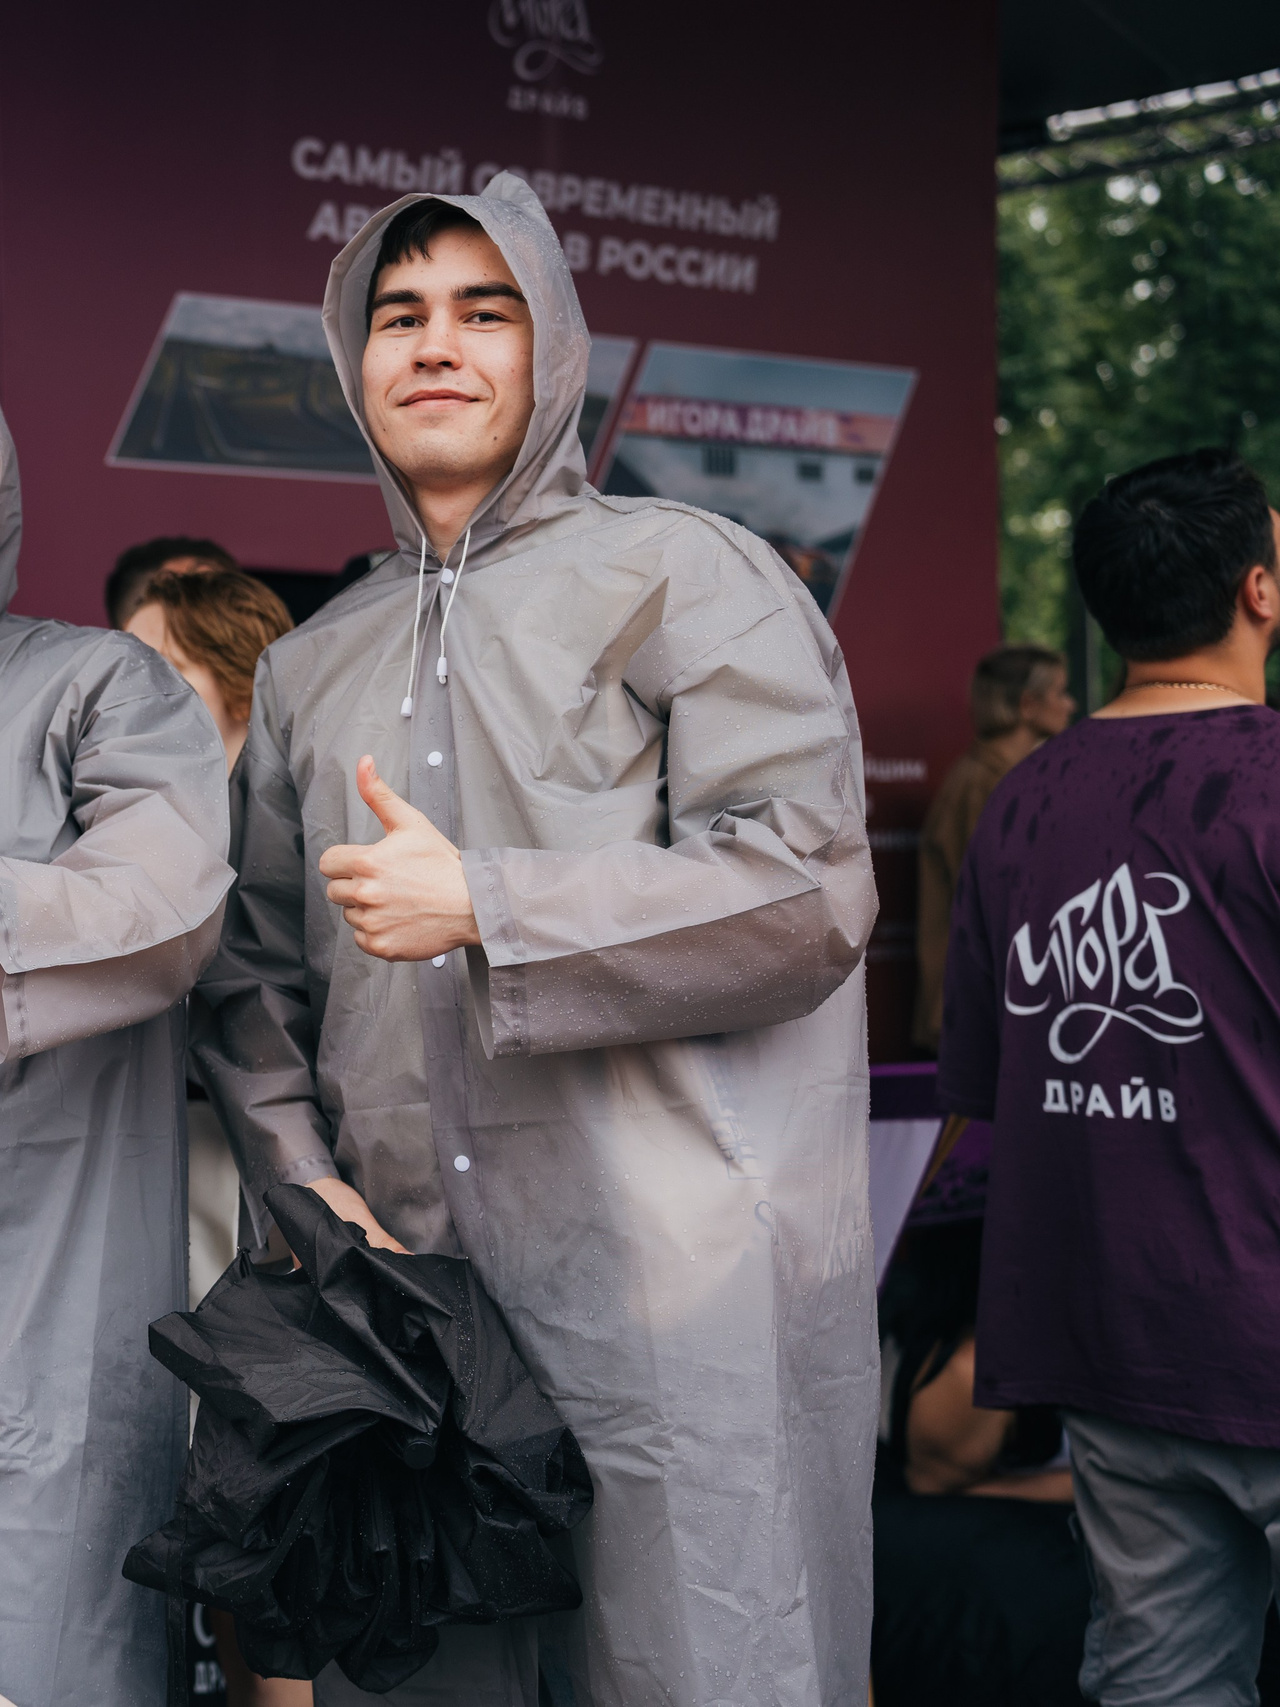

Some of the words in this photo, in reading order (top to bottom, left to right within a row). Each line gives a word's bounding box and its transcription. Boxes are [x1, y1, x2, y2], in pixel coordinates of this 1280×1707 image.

[291, 136, 464, 195] САМЫЙ
[473, 162, 779, 243] СВРЕМЕННЫЙ
[596, 236, 758, 295] РОССИИ
[646, 401, 741, 440] ИГОРА
[1042, 1076, 1177, 1123] ДРАЙВ
